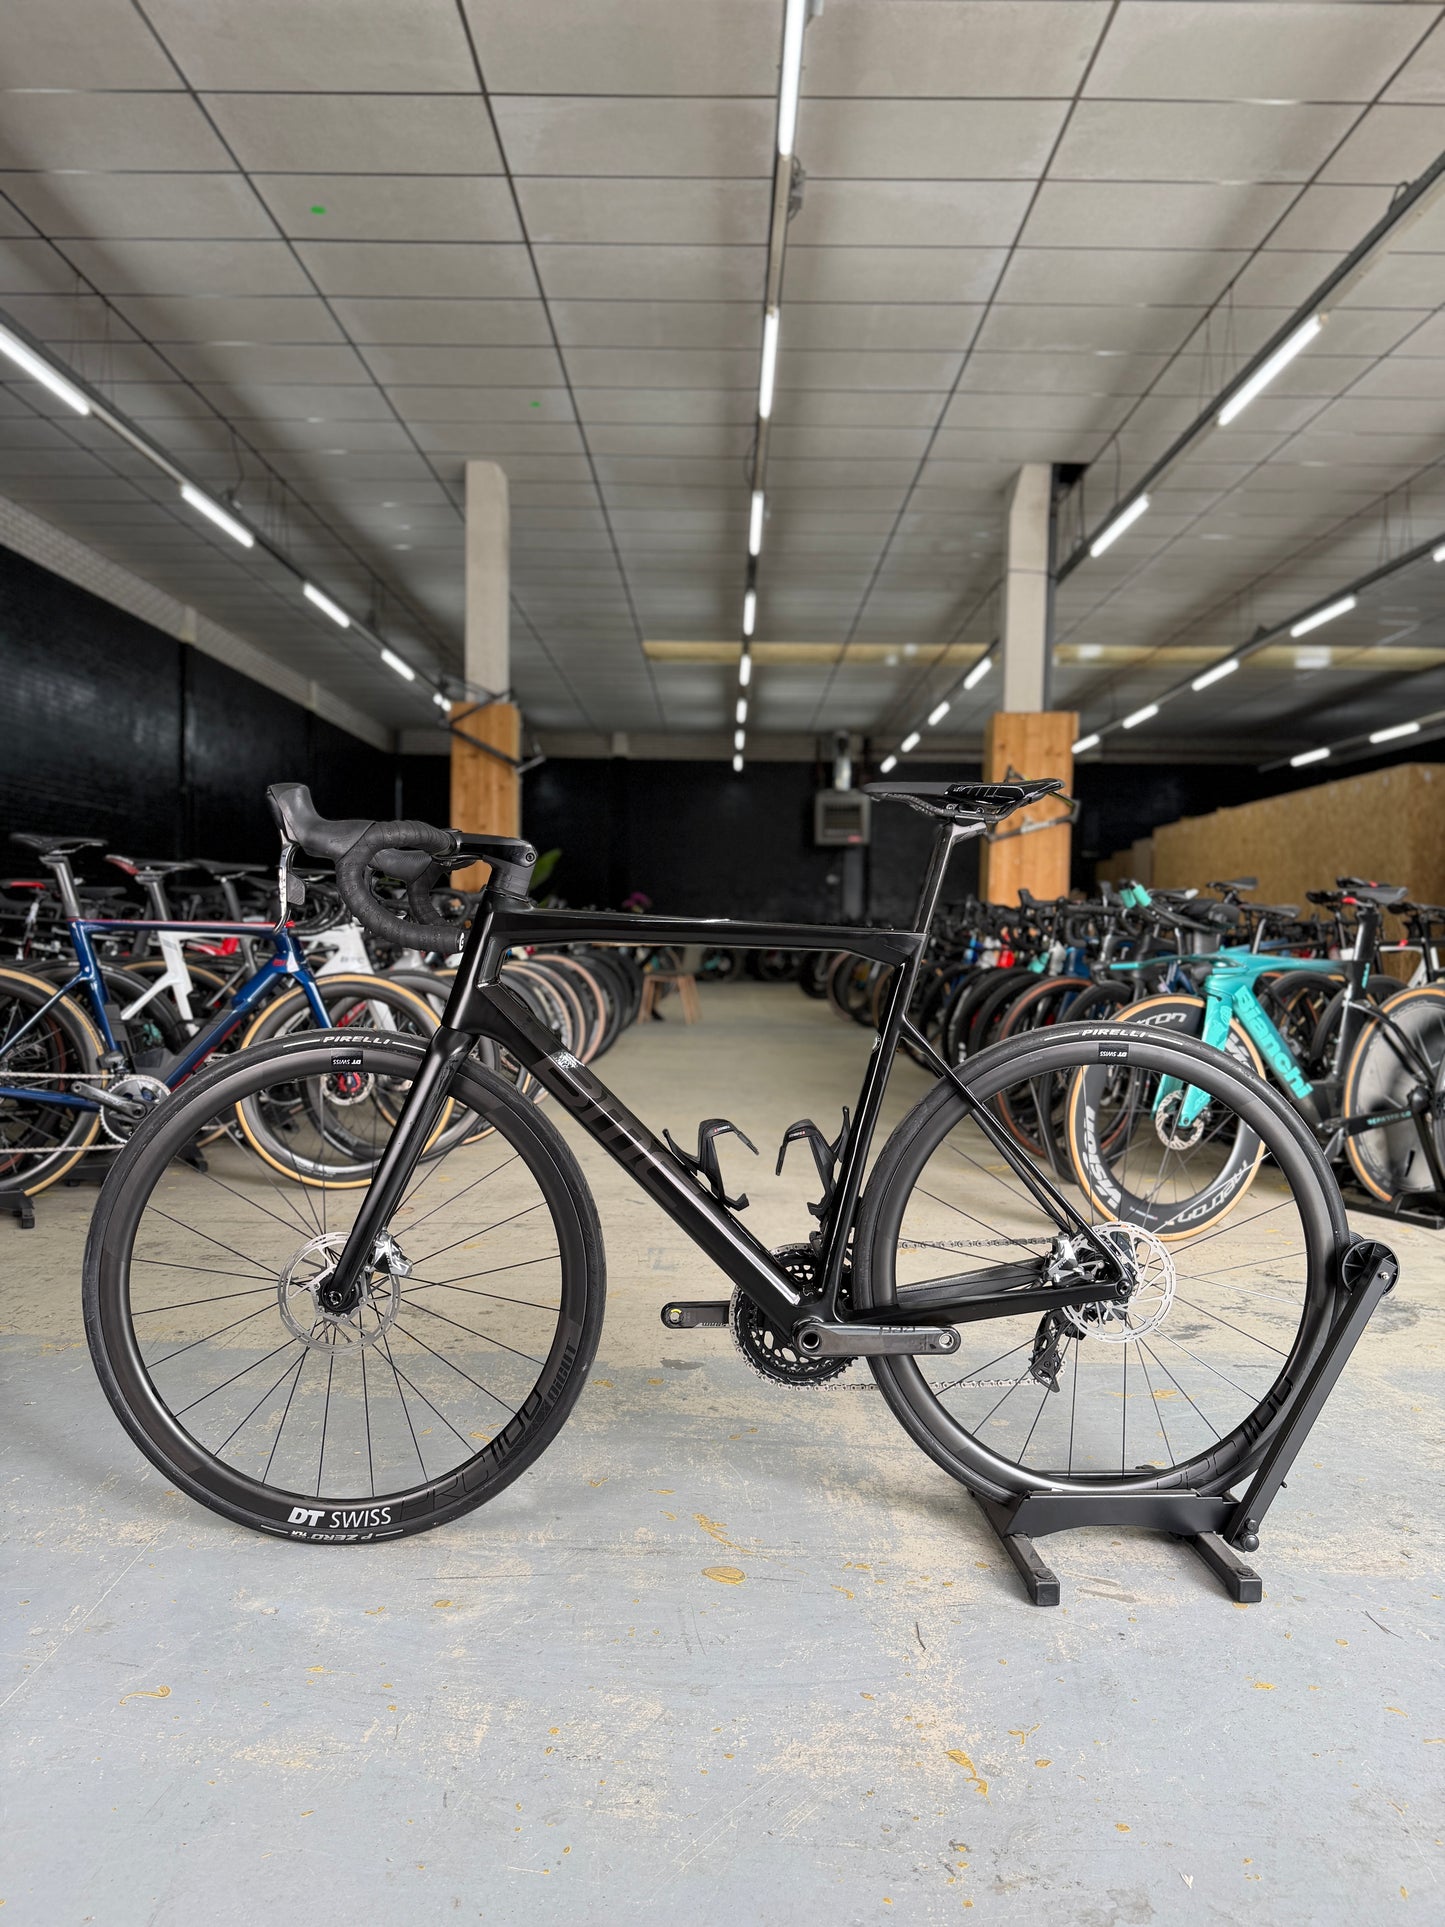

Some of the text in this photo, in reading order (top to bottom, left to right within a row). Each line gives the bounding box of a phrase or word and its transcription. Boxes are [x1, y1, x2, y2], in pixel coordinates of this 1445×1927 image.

[1137, 1012, 1187, 1026] ron
[1081, 1028, 1146, 1038] PIRELLI
[322, 1035, 391, 1045] PIRELLI
[1234, 985, 1314, 1099] Bianchi
[530, 1047, 701, 1208] BMC
[287, 1506, 392, 1529] DT SWISS
[310, 1533, 359, 1541] ZERO
[360, 1532, 374, 1540] P
